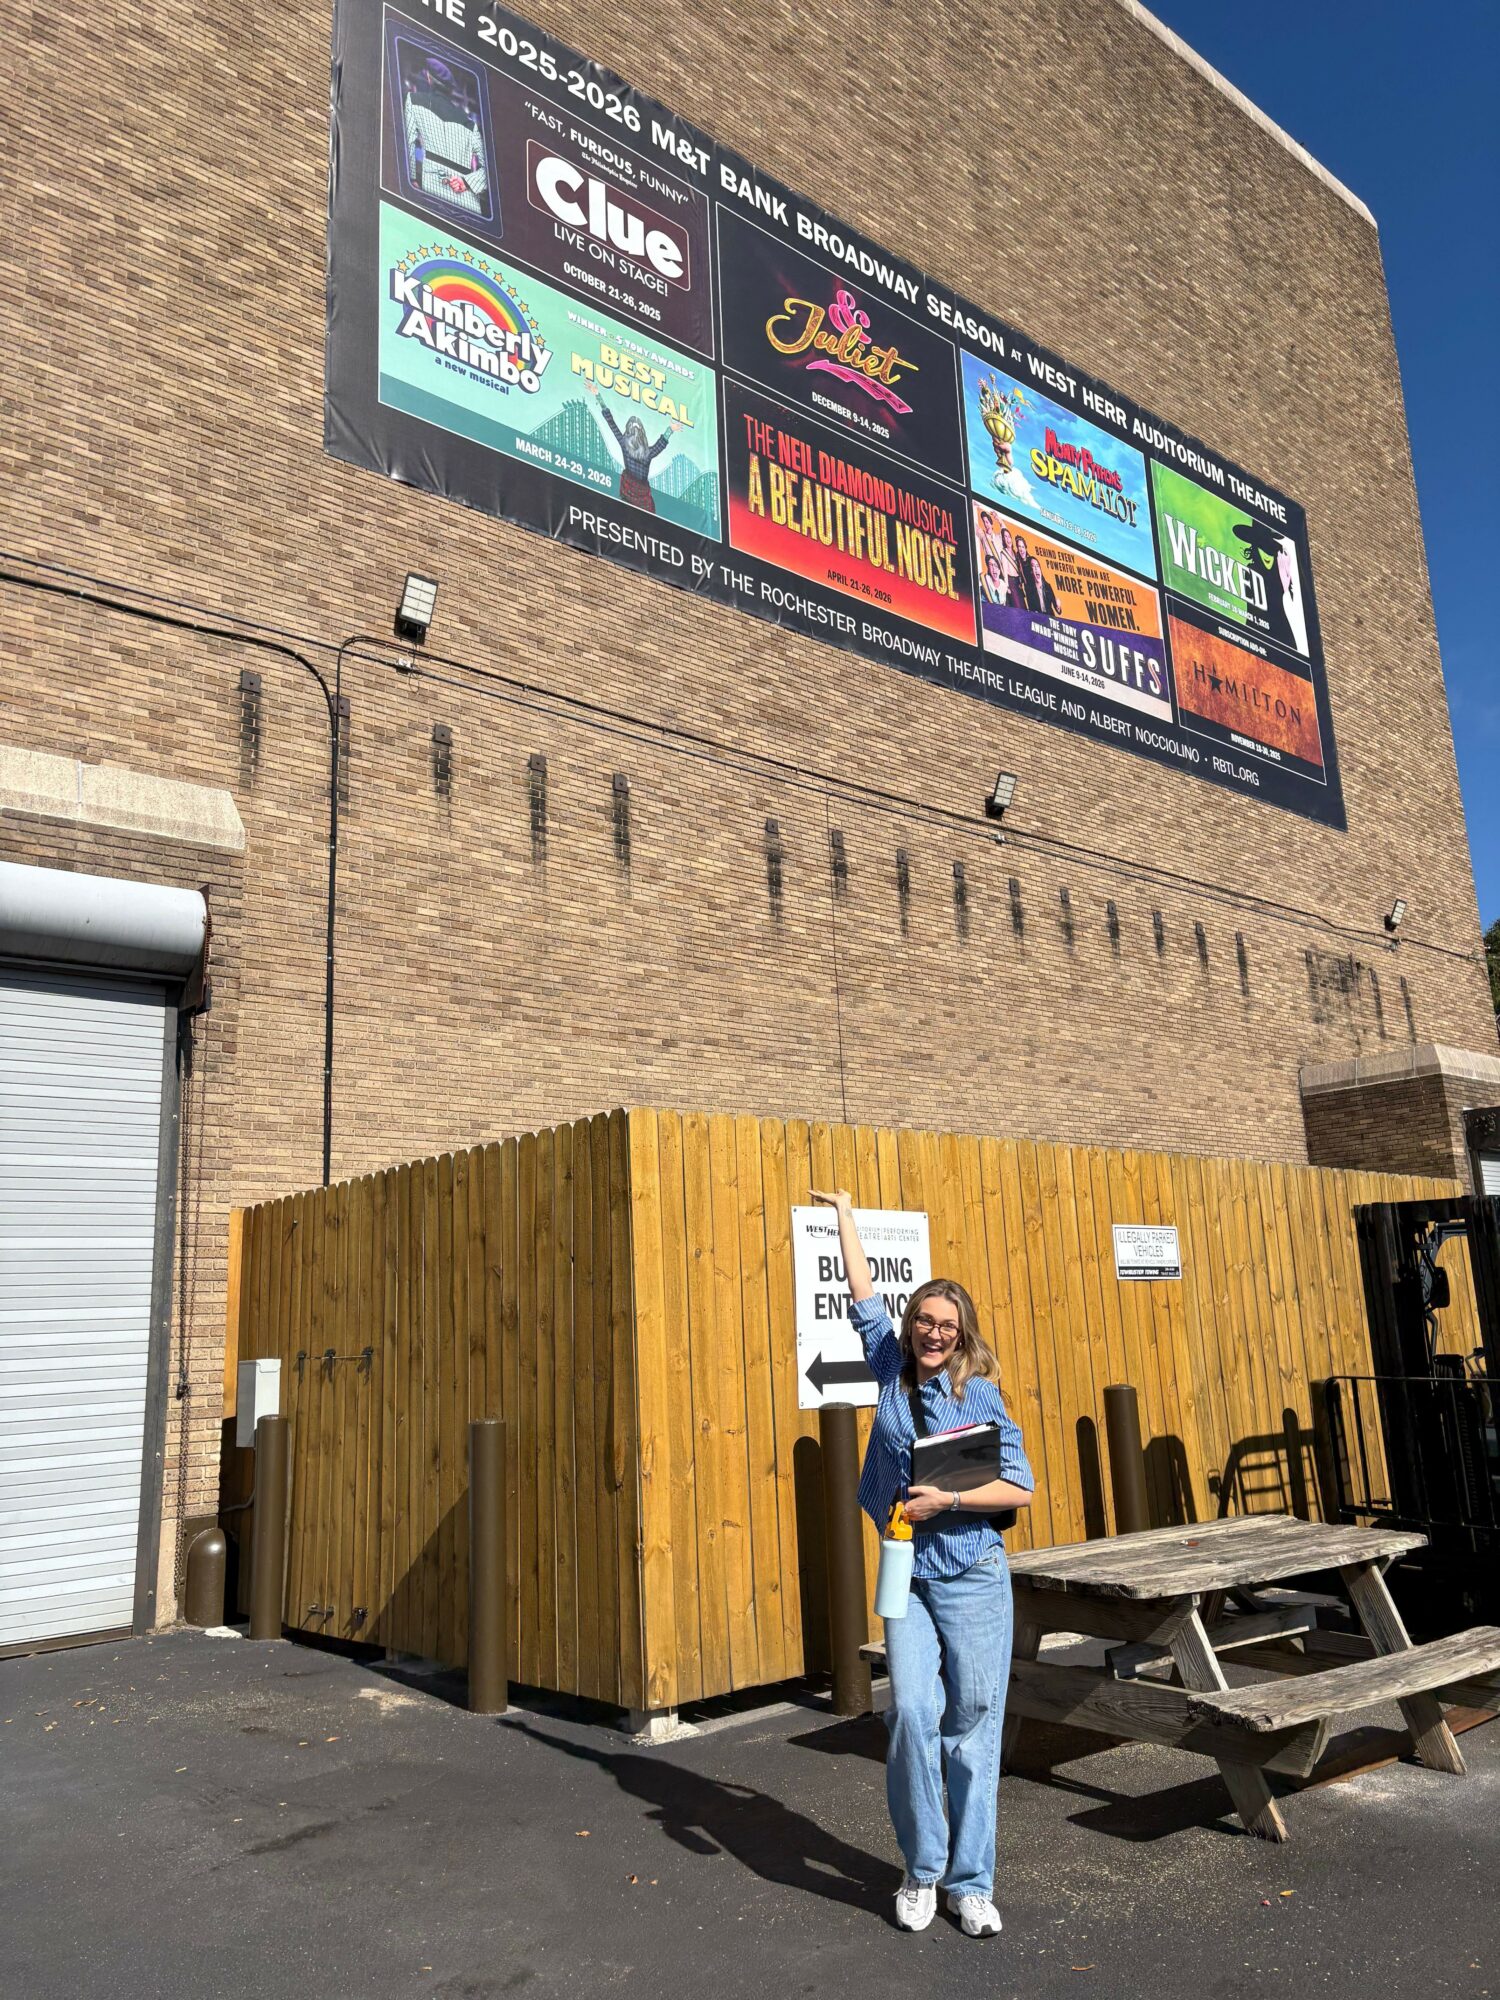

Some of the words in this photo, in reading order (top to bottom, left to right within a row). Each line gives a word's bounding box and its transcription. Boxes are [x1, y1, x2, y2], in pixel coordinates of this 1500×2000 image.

[571, 128, 636, 179] FURIOUS,
[535, 156, 684, 279] Clue
[478, 15, 641, 132] 2025-2026
[651, 120, 711, 176] M&T
[720, 164, 789, 227] BANK
[797, 212, 919, 304] BROADWAY
[927, 294, 1005, 357] SEASON
[1011, 349, 1022, 362] AT
[1027, 353, 1076, 398] WEST
[1082, 387, 1127, 429] HERR
[1133, 418, 1225, 486] AUDITORIUM
[1228, 474, 1287, 524] THEATRE
[554, 223, 585, 251] LIVE
[589, 243, 615, 268] ON
[619, 259, 668, 297] STAGE!
[563, 262, 606, 293] OCTOBER
[608, 285, 637, 310] 21-26,
[639, 302, 661, 321] 2025
[391, 267, 553, 376] Kimberly
[567, 310, 608, 337] WINNER
[615, 335, 623, 345] 5
[624, 340, 650, 357] TONY
[651, 352, 695, 380] AWARDS
[766, 297, 919, 385] Juliet
[396, 309, 540, 394] Akimbo
[435, 356, 442, 365] a
[445, 358, 466, 376] new
[470, 371, 509, 395] musical
[600, 343, 666, 392] BEST
[571, 351, 694, 429] MUSICAL
[811, 391, 852, 420] DECEMBER
[853, 413, 871, 431] 9-14,
[871, 422, 890, 439] 2025
[515, 437, 552, 463] MARCH
[554, 454, 586, 479] 24-29,
[587, 470, 612, 488] 2026
[743, 413, 775, 460] THE
[778, 431, 817, 480] NEIL
[819, 450, 896, 516] DIAMOND
[899, 488, 958, 545] MUSICAL
[1031, 448, 1137, 528] SPAMALOT
[748, 452, 765, 518] A
[769, 460, 895, 574] BEAUTIFUL
[895, 520, 960, 601] NOISE
[1040, 507, 1065, 527] JANUARY
[1035, 546, 1056, 559] BEHIND
[1057, 551, 1075, 563] EVERY
[1046, 560, 1076, 575] POWERFUL
[1077, 566, 1098, 579] WOMAN
[1100, 571, 1110, 582] ARE
[827, 569, 848, 586] APRIL
[850, 578, 873, 598] 21-26,
[874, 588, 892, 604] 2026
[1055, 574, 1084, 595] MORE
[1086, 581, 1137, 606] POWERFUL
[1031, 621, 1079, 649] AWARD-WINNING
[1049, 617, 1060, 631] THE
[1062, 623, 1077, 637] TONY
[1085, 600, 1140, 631] WOMEN.
[569, 506, 684, 566] PRESENTED
[691, 554, 714, 578] BY
[720, 566, 755, 596] THE
[760, 582, 857, 635] ROCHESTER
[862, 622, 941, 667] BROADWAY
[945, 654, 1005, 692] THEATRE
[1008, 679, 1057, 711] LEAGUE
[1061, 702, 1086, 721] AND
[1090, 711, 1131, 738] ALBERT
[1135, 726, 1200, 763] NOCCIOLINO
[1213, 756, 1260, 786] RBTL.ORG
[1053, 642, 1079, 661] MUSICAL
[1081, 629, 1161, 695] SUFFS
[1061, 665, 1075, 677] JUNE
[1076, 670, 1091, 685] 9-14,
[1091, 676, 1105, 689] 2026
[1193, 661, 1301, 725] HAMILTON
[806, 1224, 828, 1233] WEST
[883, 1227, 919, 1235] PERFORMING
[860, 1232, 880, 1241] EATRE
[1133, 1245, 1164, 1258] VEHICLES
[818, 1256, 913, 1282] BUDING
[814, 1293, 913, 1319] ENTNC
